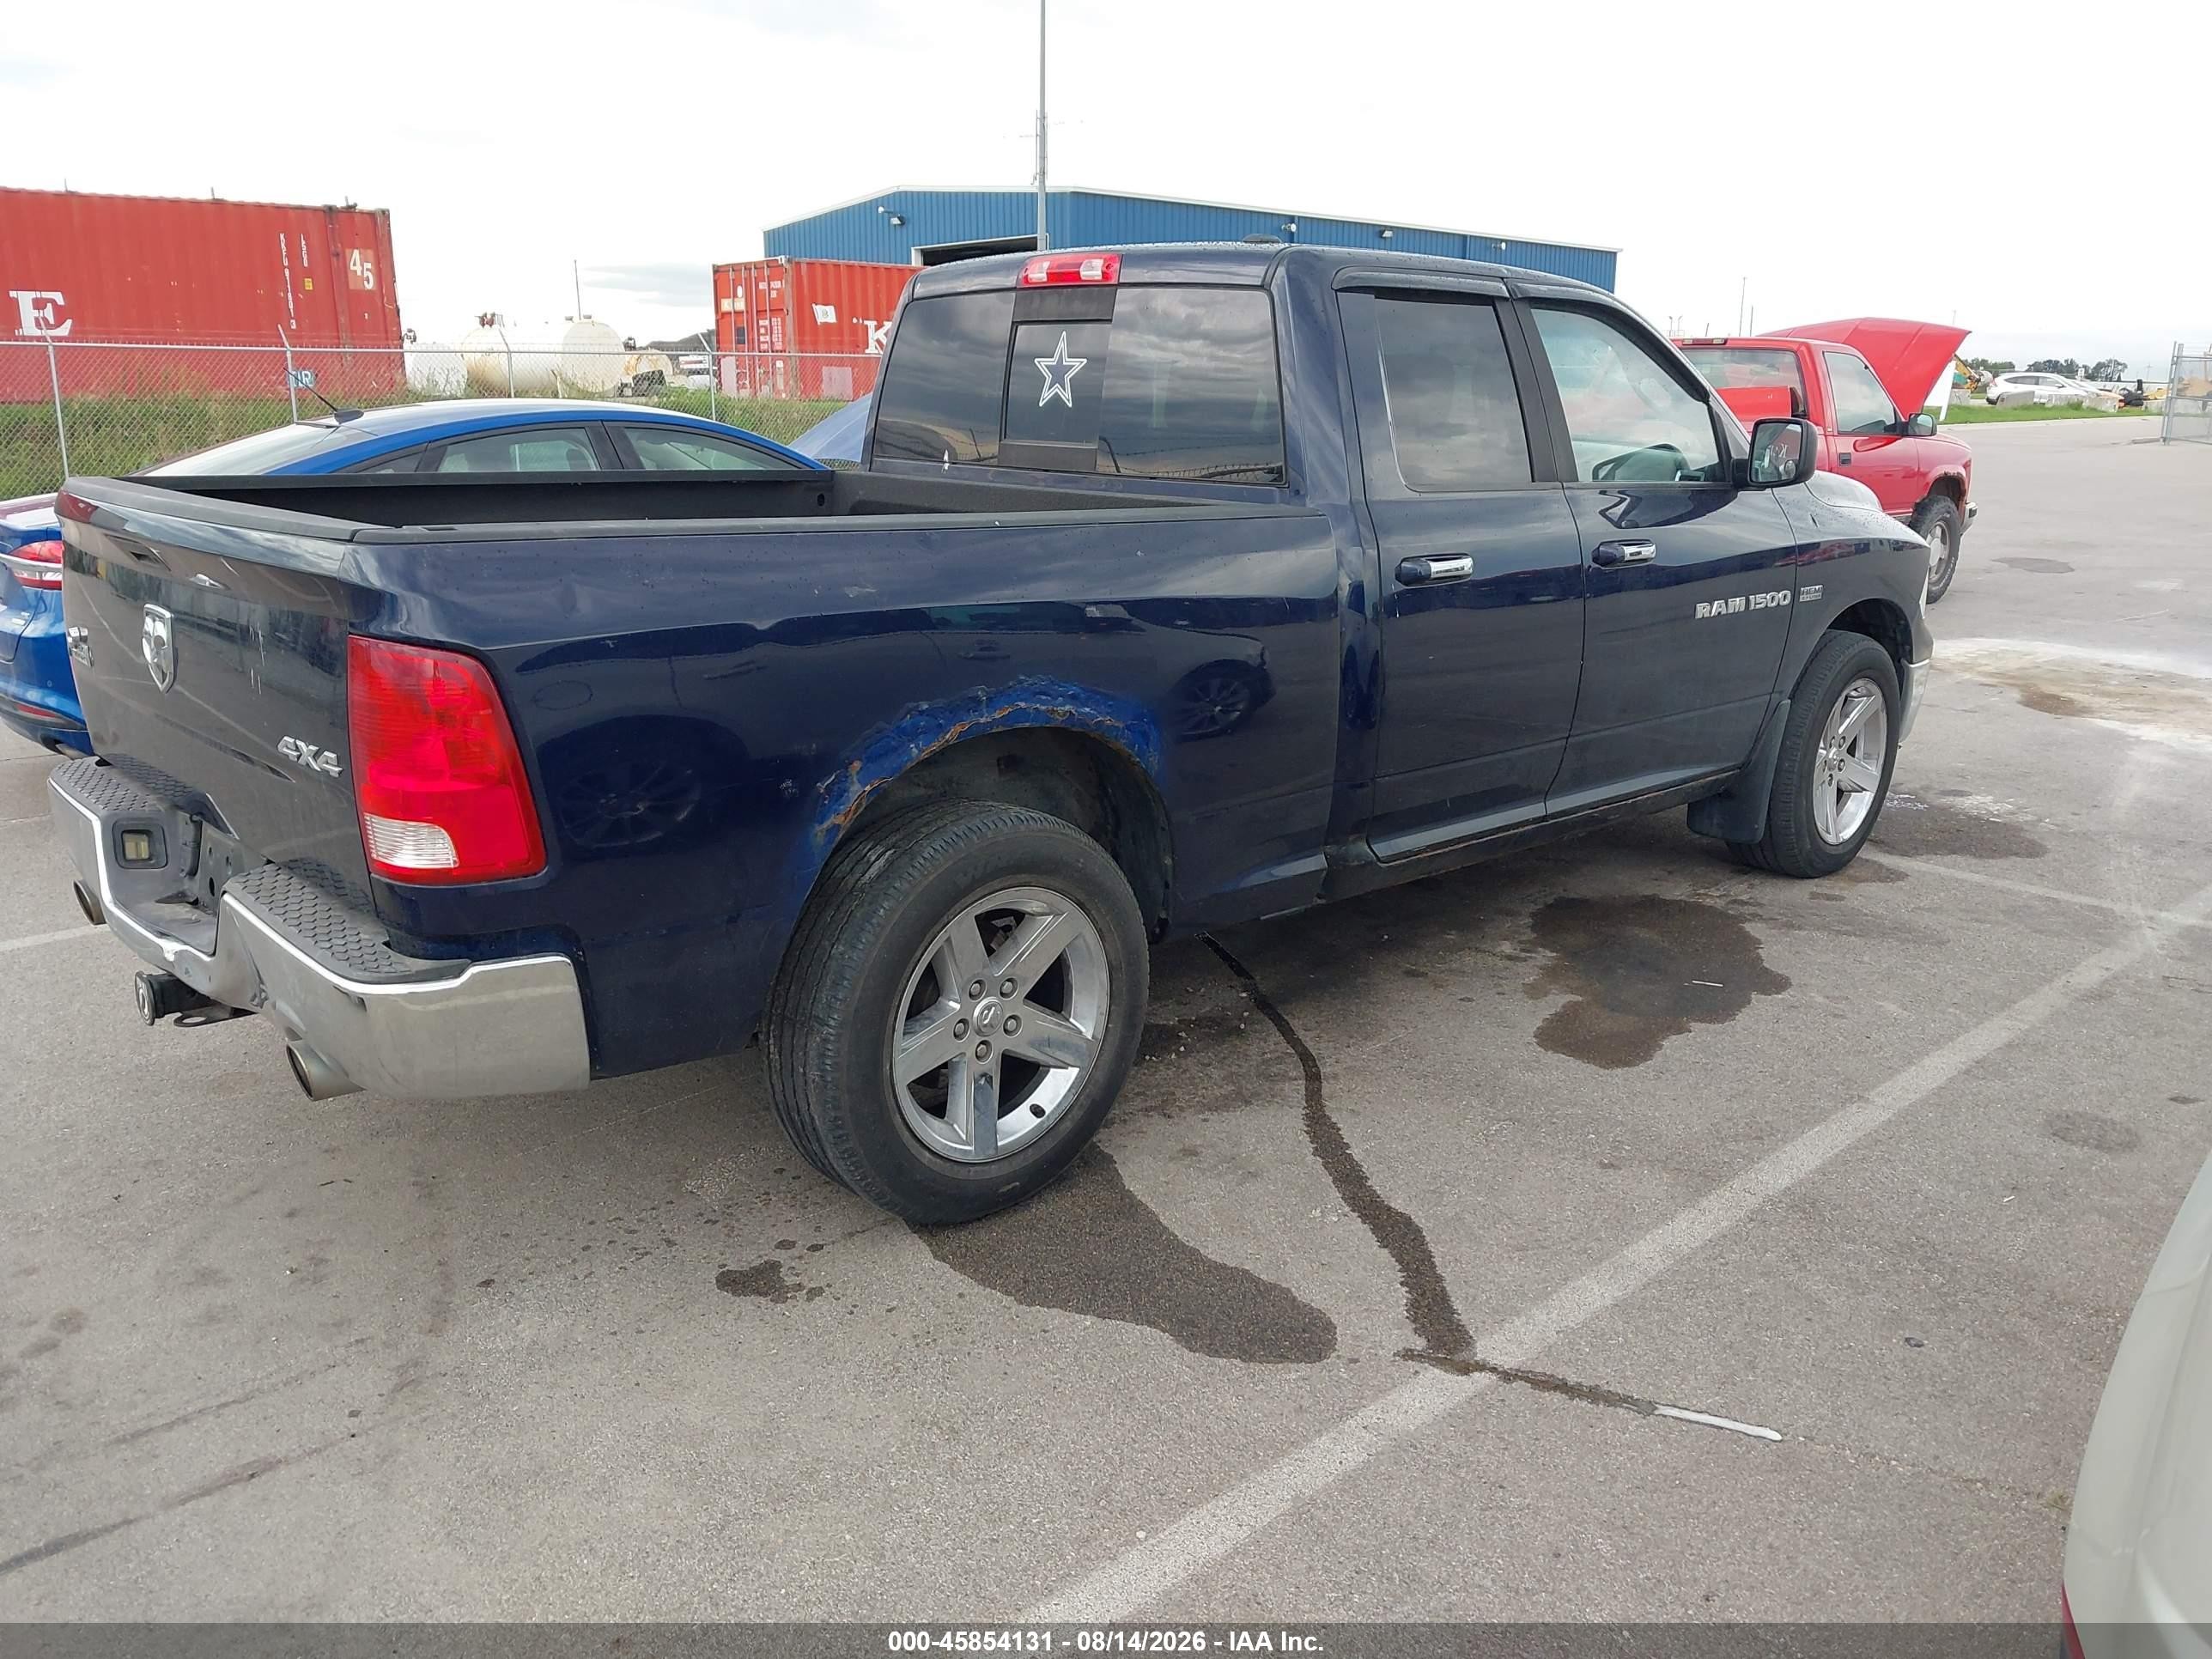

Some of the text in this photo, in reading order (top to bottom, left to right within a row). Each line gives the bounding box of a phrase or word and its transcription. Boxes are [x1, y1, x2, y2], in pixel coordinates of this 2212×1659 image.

[349, 249, 374, 289] 45
[1695, 590, 1791, 619] RAM 1500
[1801, 586, 1822, 595] HEMI
